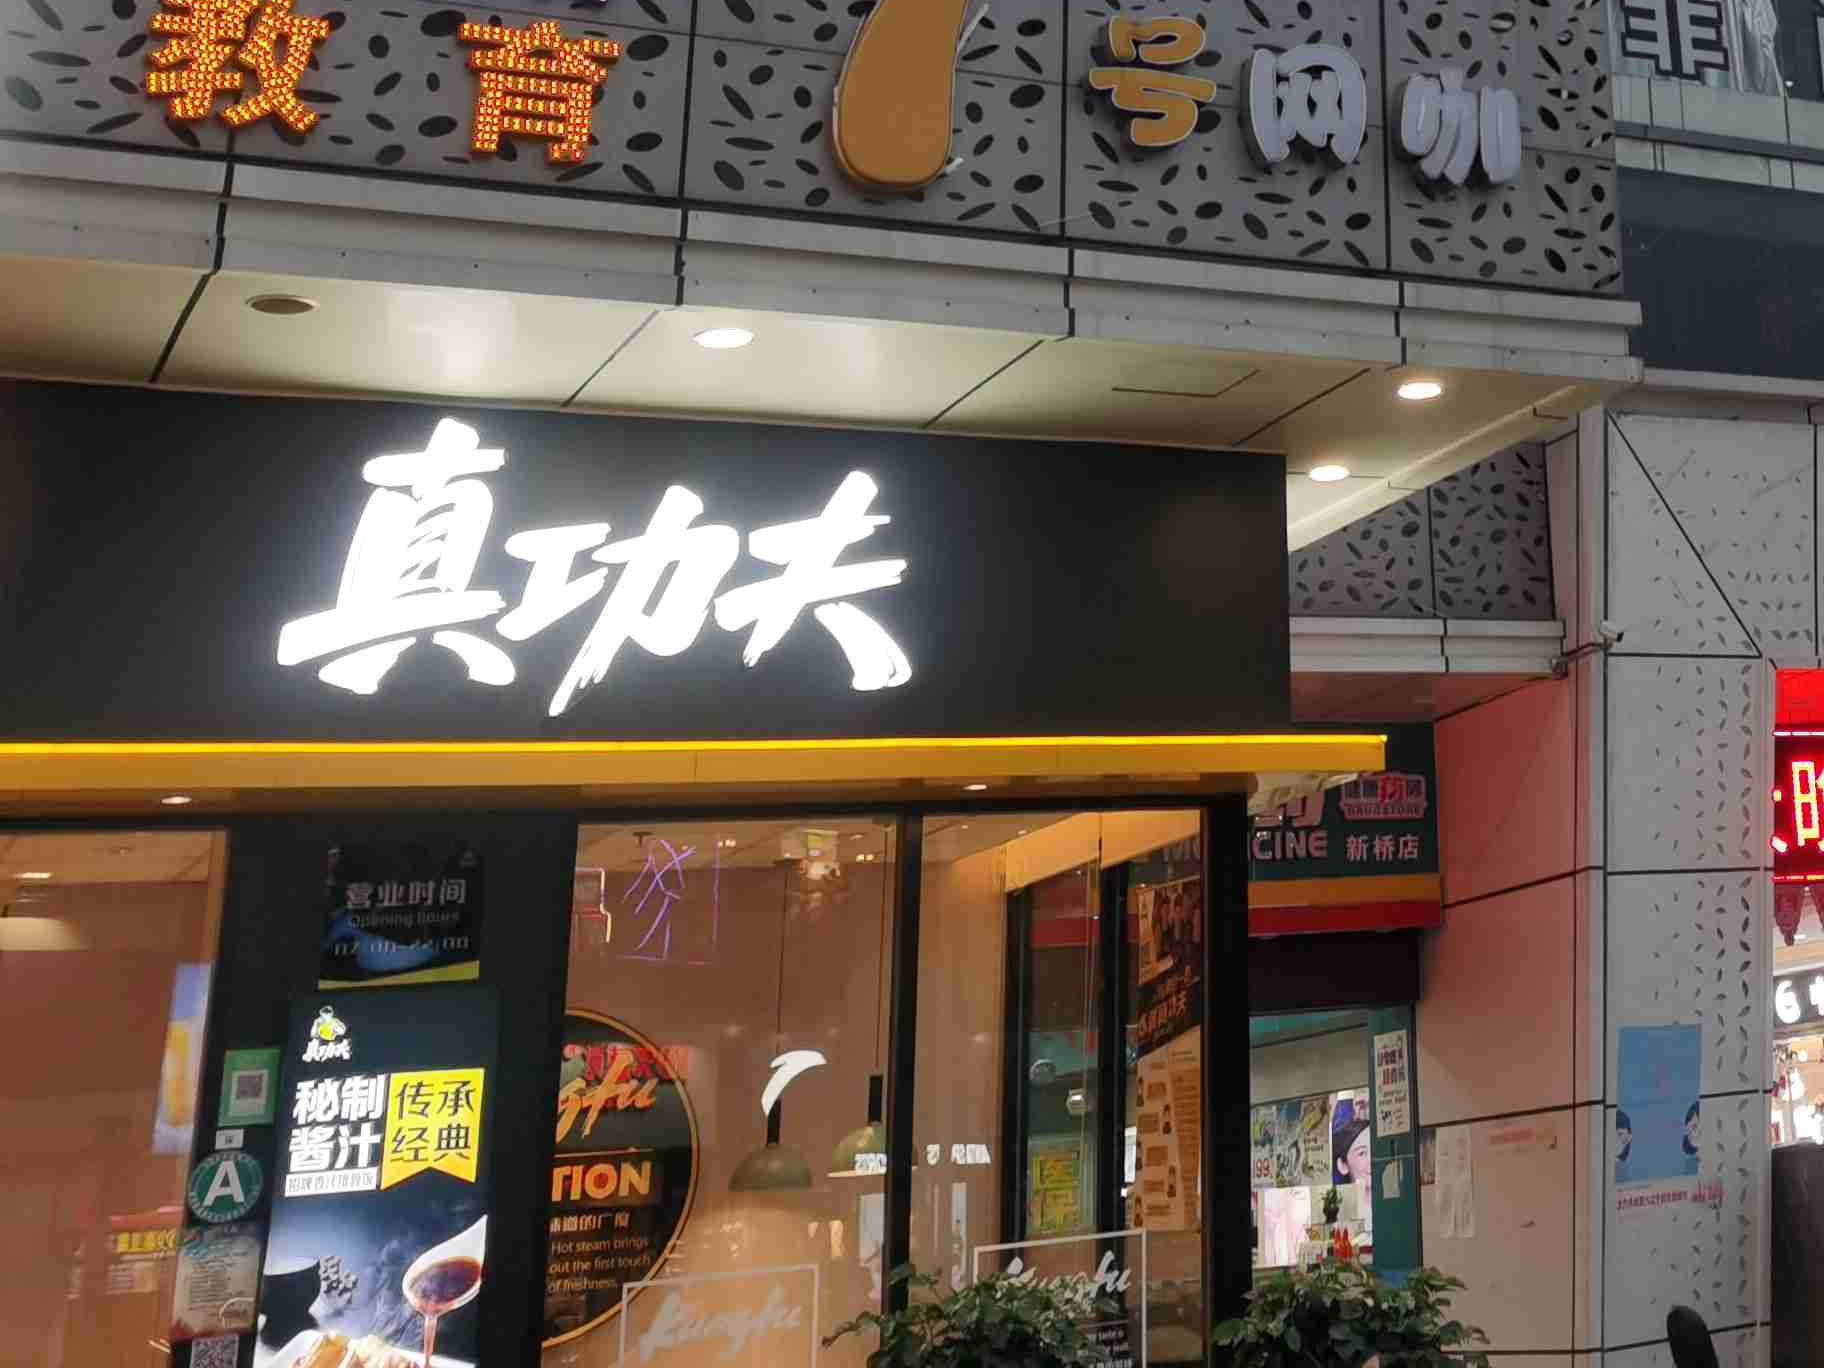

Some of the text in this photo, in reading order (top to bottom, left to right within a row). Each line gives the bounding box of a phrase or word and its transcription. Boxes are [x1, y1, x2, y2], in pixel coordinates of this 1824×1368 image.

[275, 417, 913, 718] 真功夫
[293, 1074, 386, 1125] 秘制
[396, 1080, 475, 1120] 传承
[289, 1122, 382, 1173] 酱汁
[391, 1123, 471, 1163] 经典
